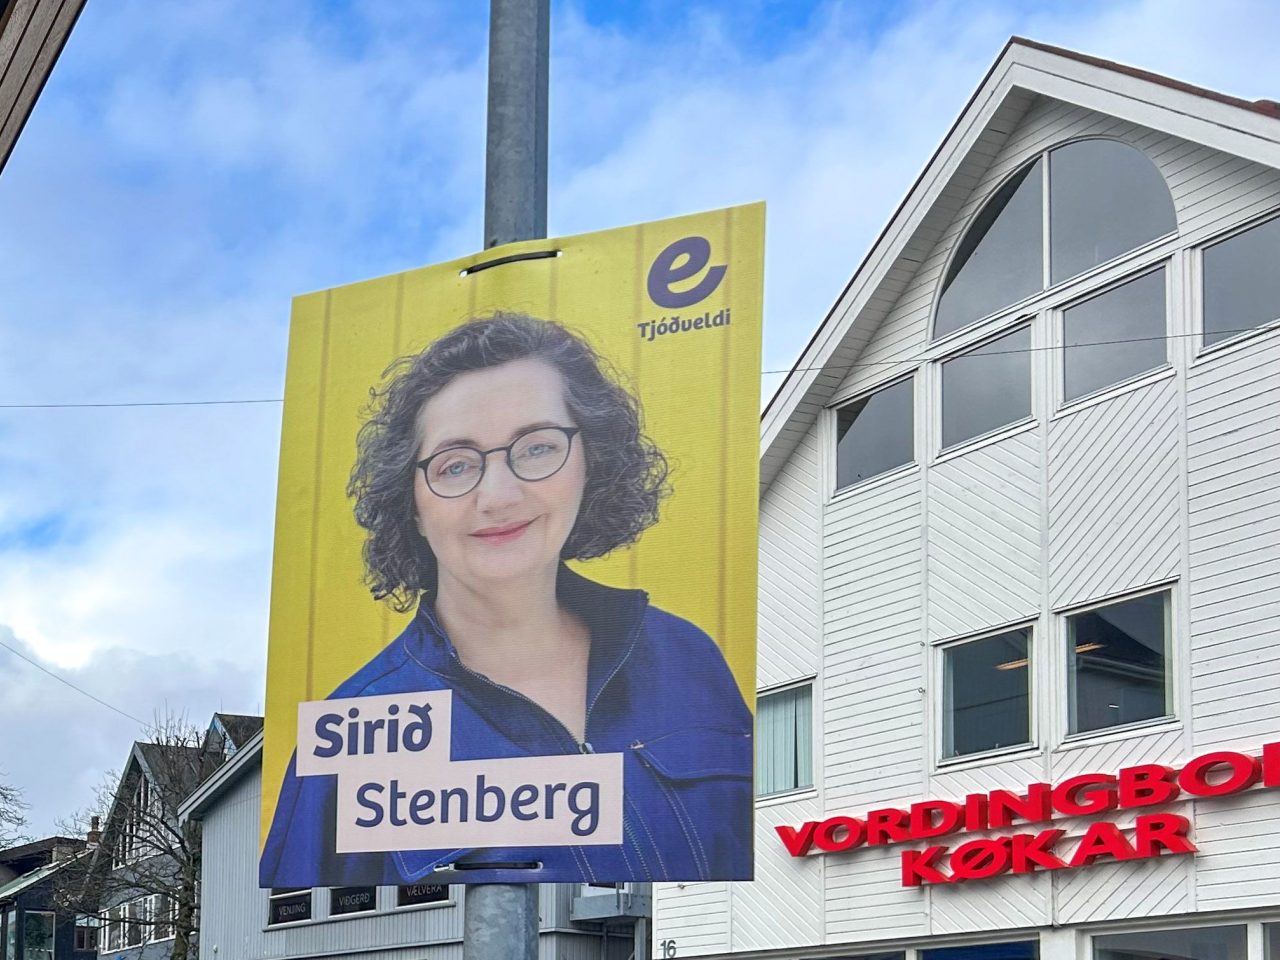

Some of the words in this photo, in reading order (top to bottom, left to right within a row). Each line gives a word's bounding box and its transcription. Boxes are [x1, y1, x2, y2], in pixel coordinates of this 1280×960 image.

[637, 308, 731, 342] Tjóðveldi
[313, 703, 433, 758] Sirið
[355, 775, 600, 837] Stenberg
[901, 813, 1199, 889] KØKAR
[660, 940, 677, 959] 16
